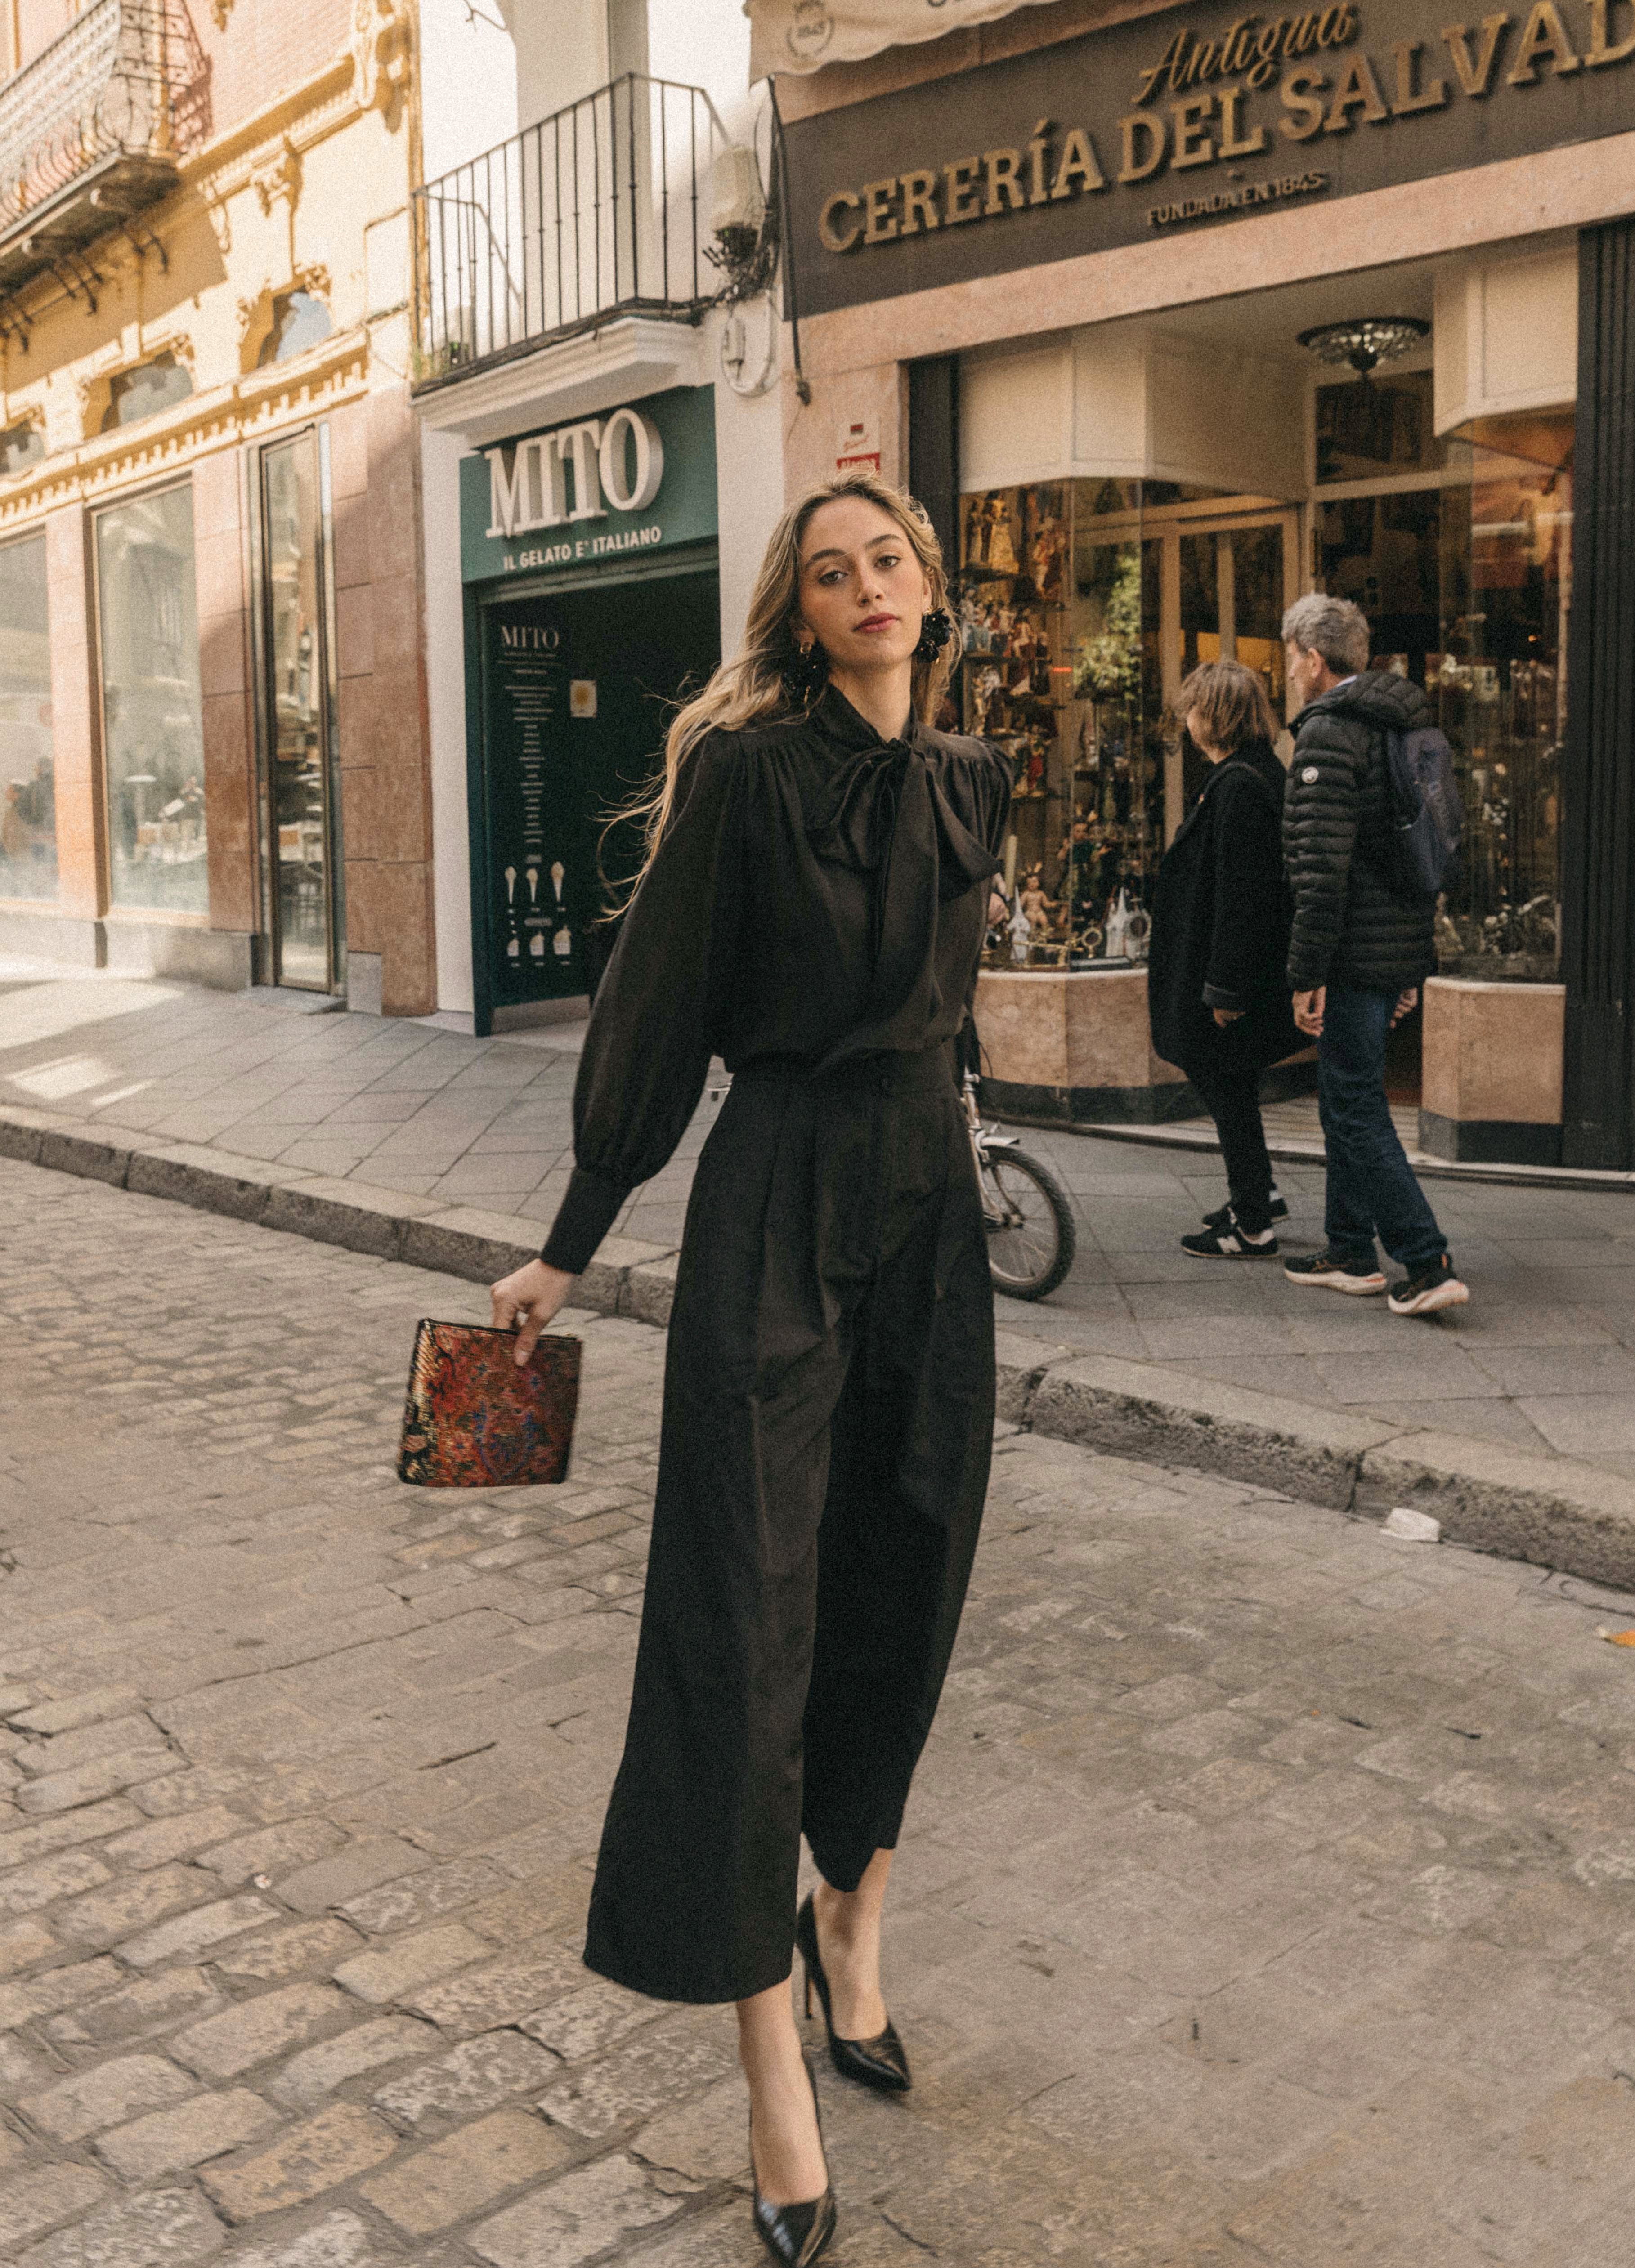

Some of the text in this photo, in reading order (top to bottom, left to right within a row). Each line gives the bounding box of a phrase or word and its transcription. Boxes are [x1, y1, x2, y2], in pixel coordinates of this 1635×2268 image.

[1131, 2, 1351, 104] Antigua
[819, 0, 1635, 253] CERERÍA DEL SALVAD
[1147, 191, 1238, 227] FUNDADA
[1243, 180, 1270, 205] EN
[484, 408, 663, 539] MITO
[503, 555, 516, 572] IL
[520, 544, 571, 568] GELATO
[592, 526, 662, 555] ITALIANO
[501, 626, 560, 648] MITO
